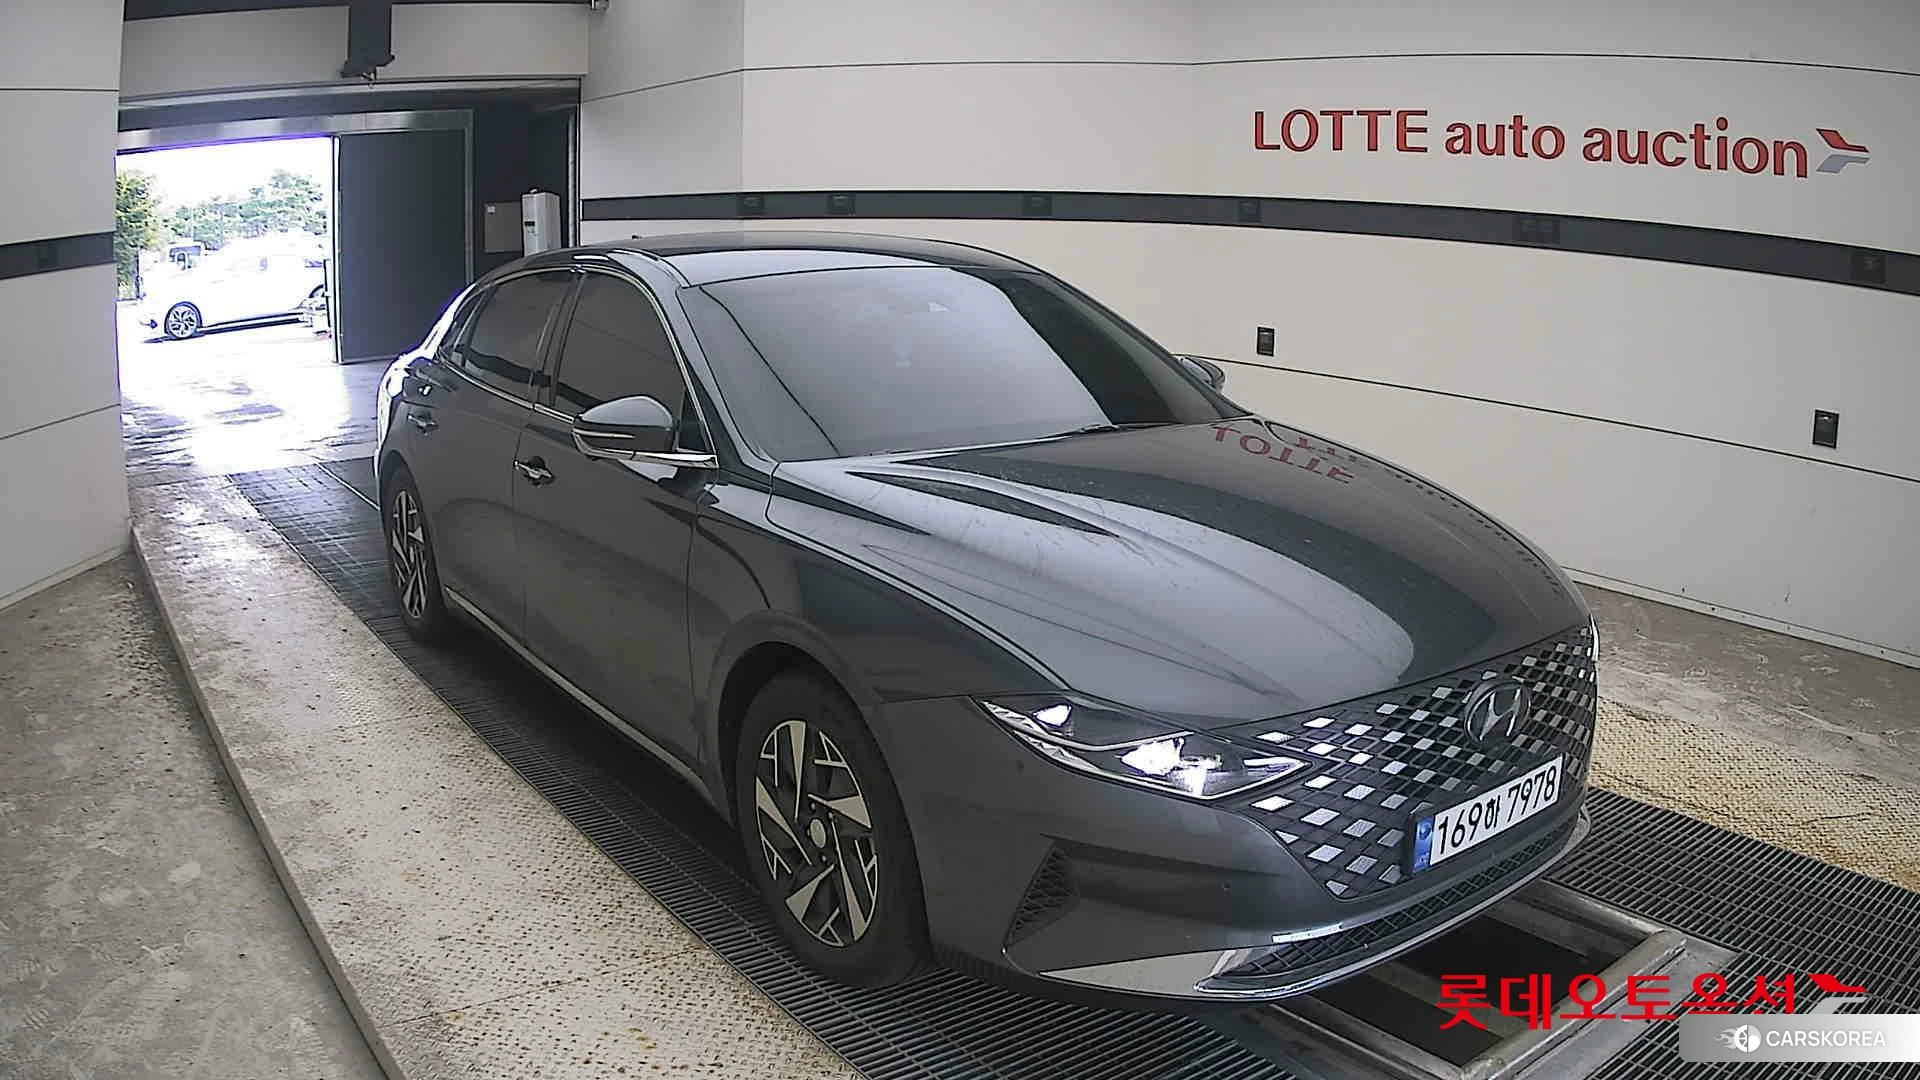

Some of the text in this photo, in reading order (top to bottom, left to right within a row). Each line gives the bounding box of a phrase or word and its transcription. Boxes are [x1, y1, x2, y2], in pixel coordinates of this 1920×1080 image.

[1254, 110, 1808, 179] LOTTE auto auction
[1507, 765, 1557, 823] 7978
